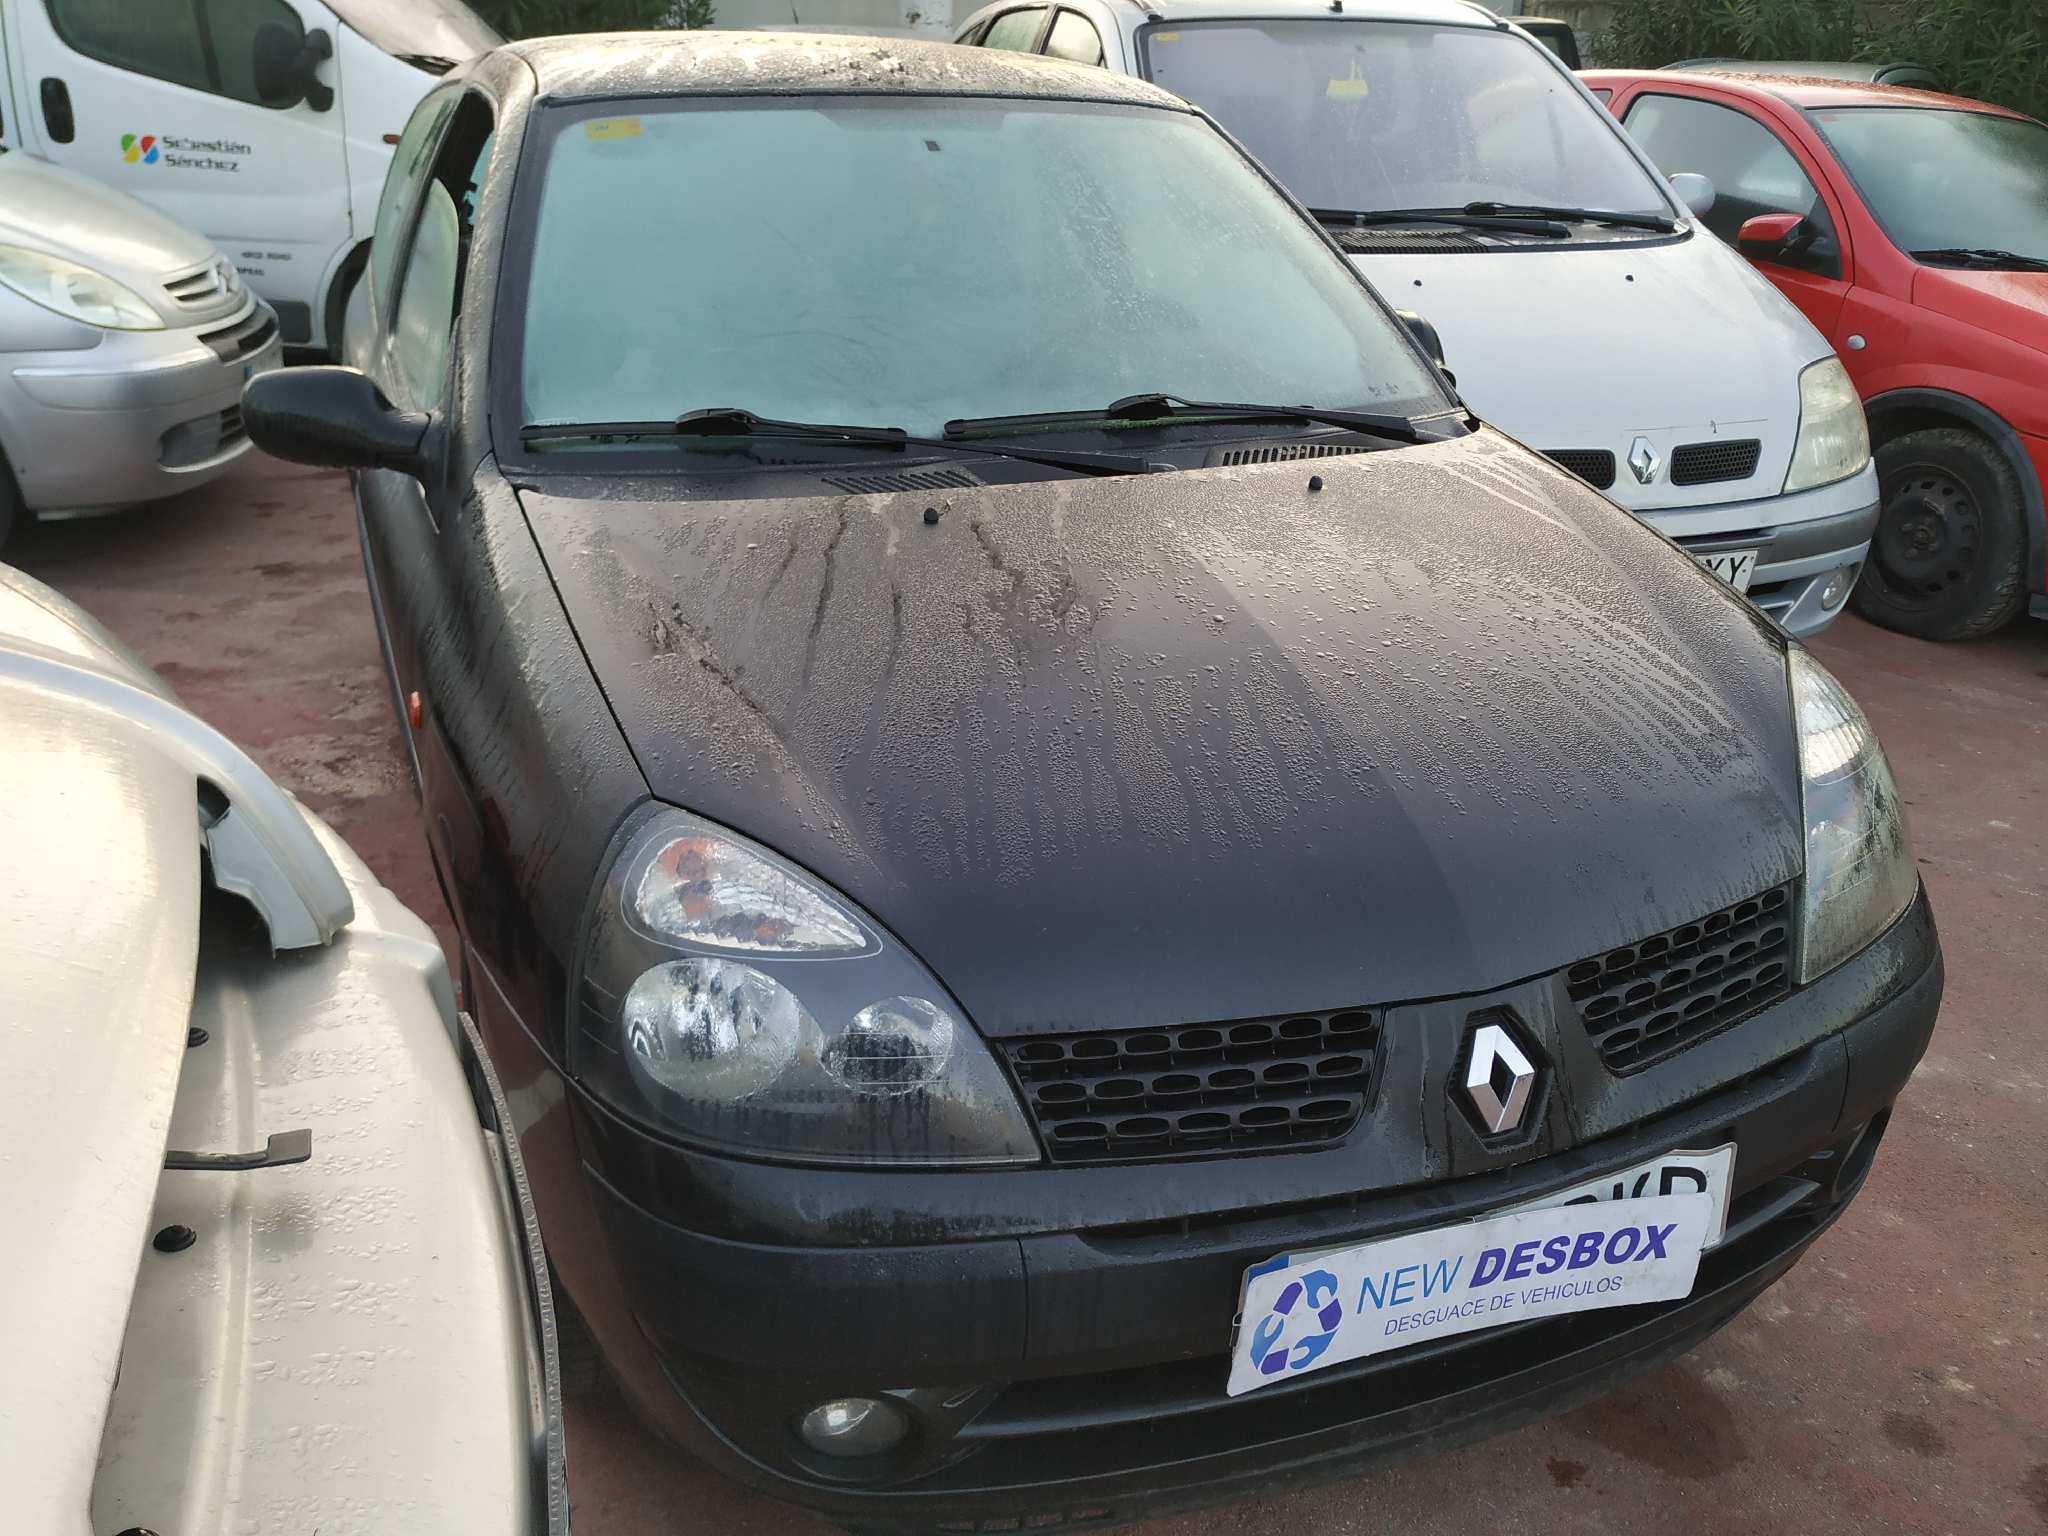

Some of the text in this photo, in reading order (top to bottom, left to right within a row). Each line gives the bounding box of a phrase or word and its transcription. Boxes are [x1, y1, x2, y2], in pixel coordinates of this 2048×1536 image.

[1356, 1223, 1678, 1314] NEW DESBOX
[1384, 1275, 1623, 1336] DESGUACE DE VEHICULOS
